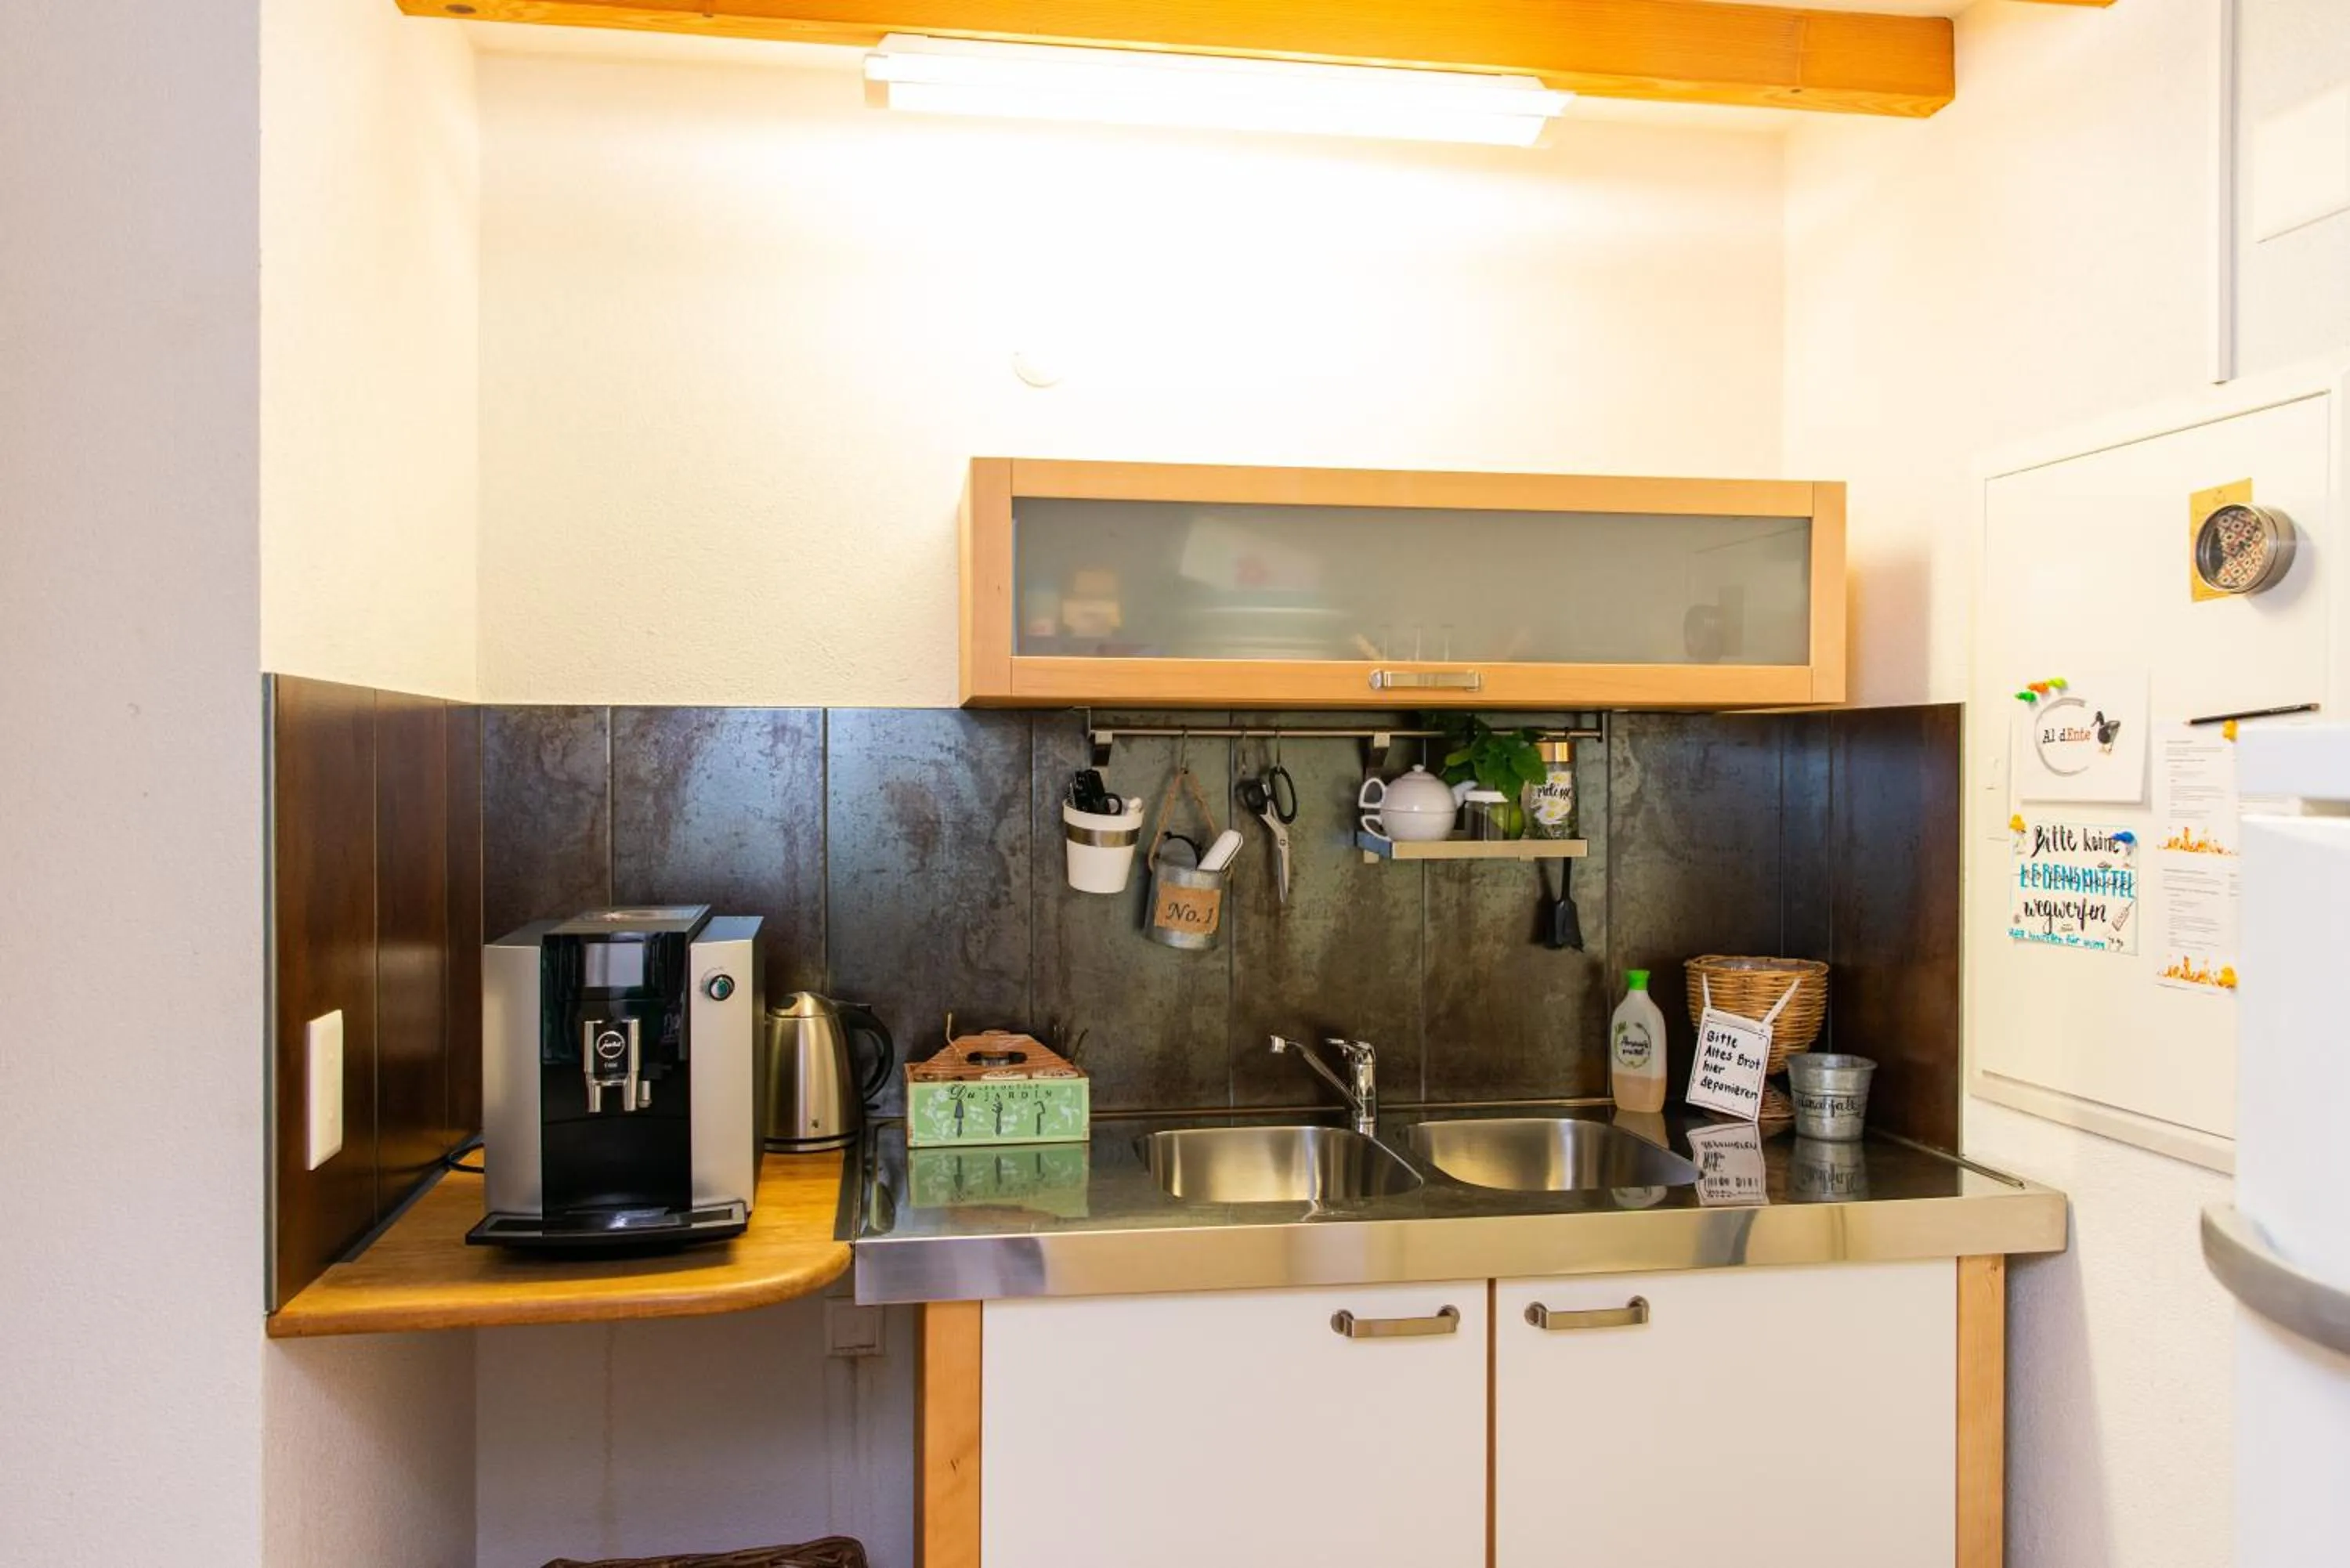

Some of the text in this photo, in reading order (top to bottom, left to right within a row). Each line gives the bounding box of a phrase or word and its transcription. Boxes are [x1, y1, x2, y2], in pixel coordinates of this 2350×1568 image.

[2042, 728, 2055, 744] Al
[2030, 825, 2077, 858] Bitte
[2019, 862, 2135, 899] LEBENSMITTEL
[2023, 897, 2107, 935] wegwerfen
[1707, 1030, 1738, 1049] Bitte
[1702, 1060, 1726, 1075] hier
[1704, 1044, 1762, 1071] Altes Brot
[984, 1089, 1052, 1102] JARDIN
[1700, 1075, 1759, 1100] deponieren
